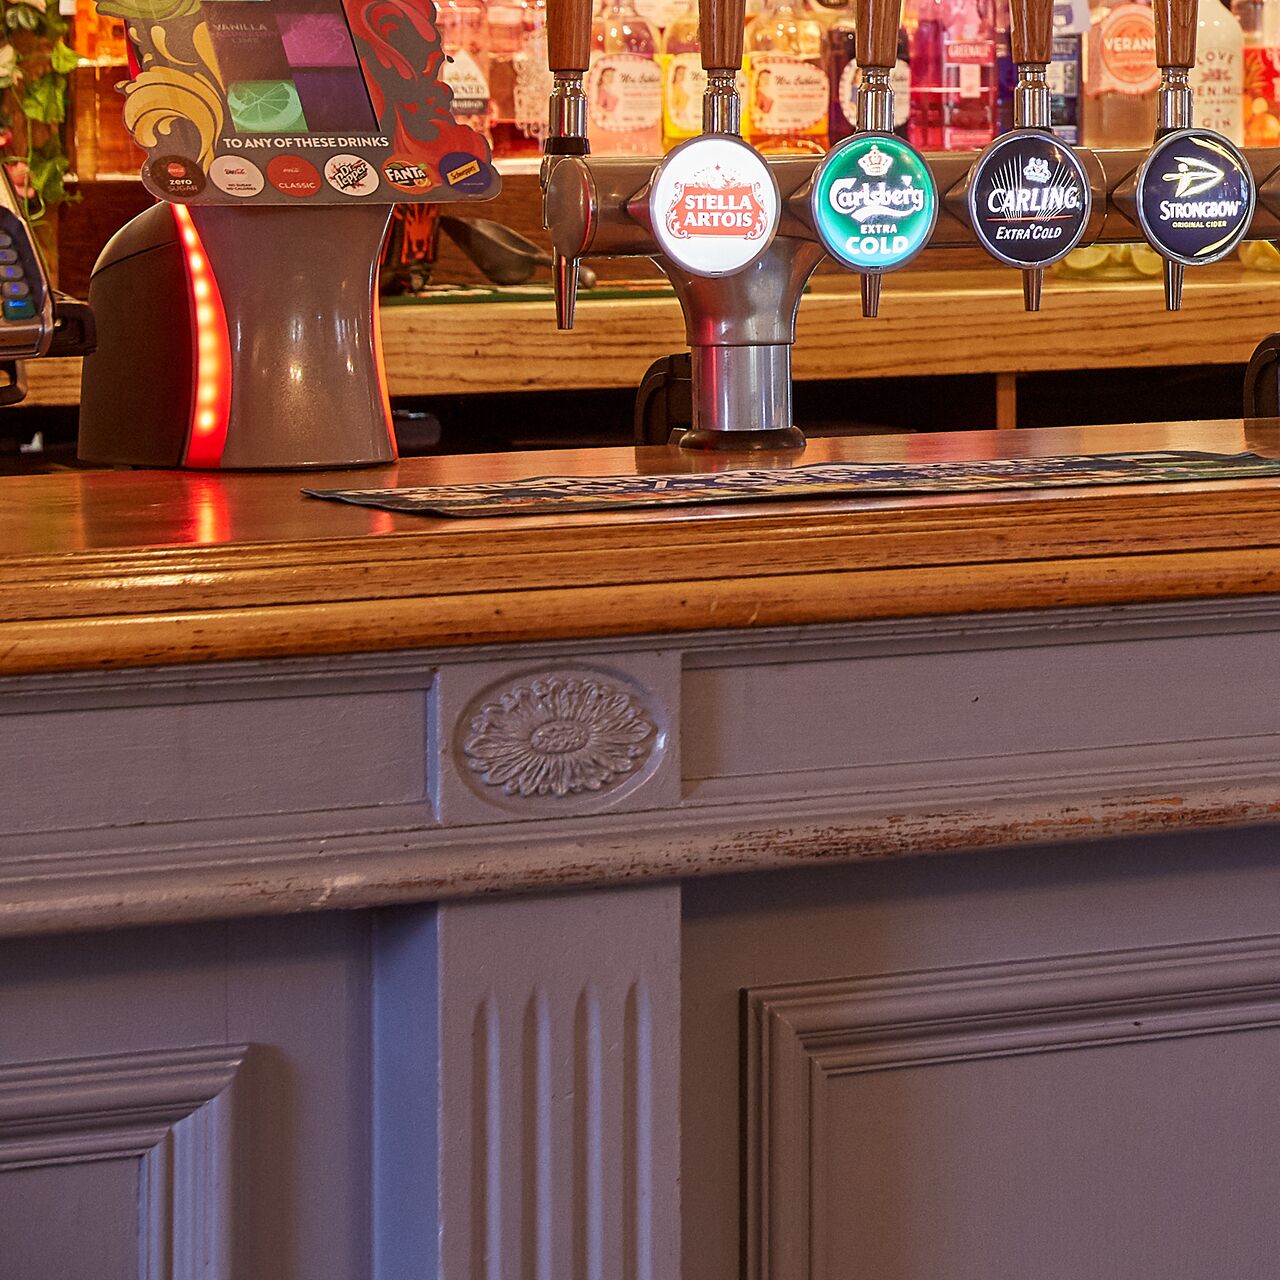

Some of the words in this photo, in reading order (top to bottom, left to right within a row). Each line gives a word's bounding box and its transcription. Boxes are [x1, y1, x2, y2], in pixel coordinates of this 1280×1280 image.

[1202, 119, 1232, 128] GIN
[223, 138, 243, 149] TO
[245, 138, 272, 148] ANY
[274, 138, 293, 148] OF
[293, 137, 336, 148] THESE
[339, 136, 389, 147] DRINKS
[335, 163, 367, 189] Pepper
[340, 163, 352, 174] Dr
[384, 167, 427, 182] FANTA
[684, 193, 752, 211] STELLA
[829, 175, 924, 216] Carlsberg
[1159, 200, 1240, 220] STRONGBOW
[683, 210, 753, 228] ARTOIS
[1206, 220, 1227, 228] CIDER
[860, 223, 897, 234] EXTRA
[845, 236, 908, 255] COLD
